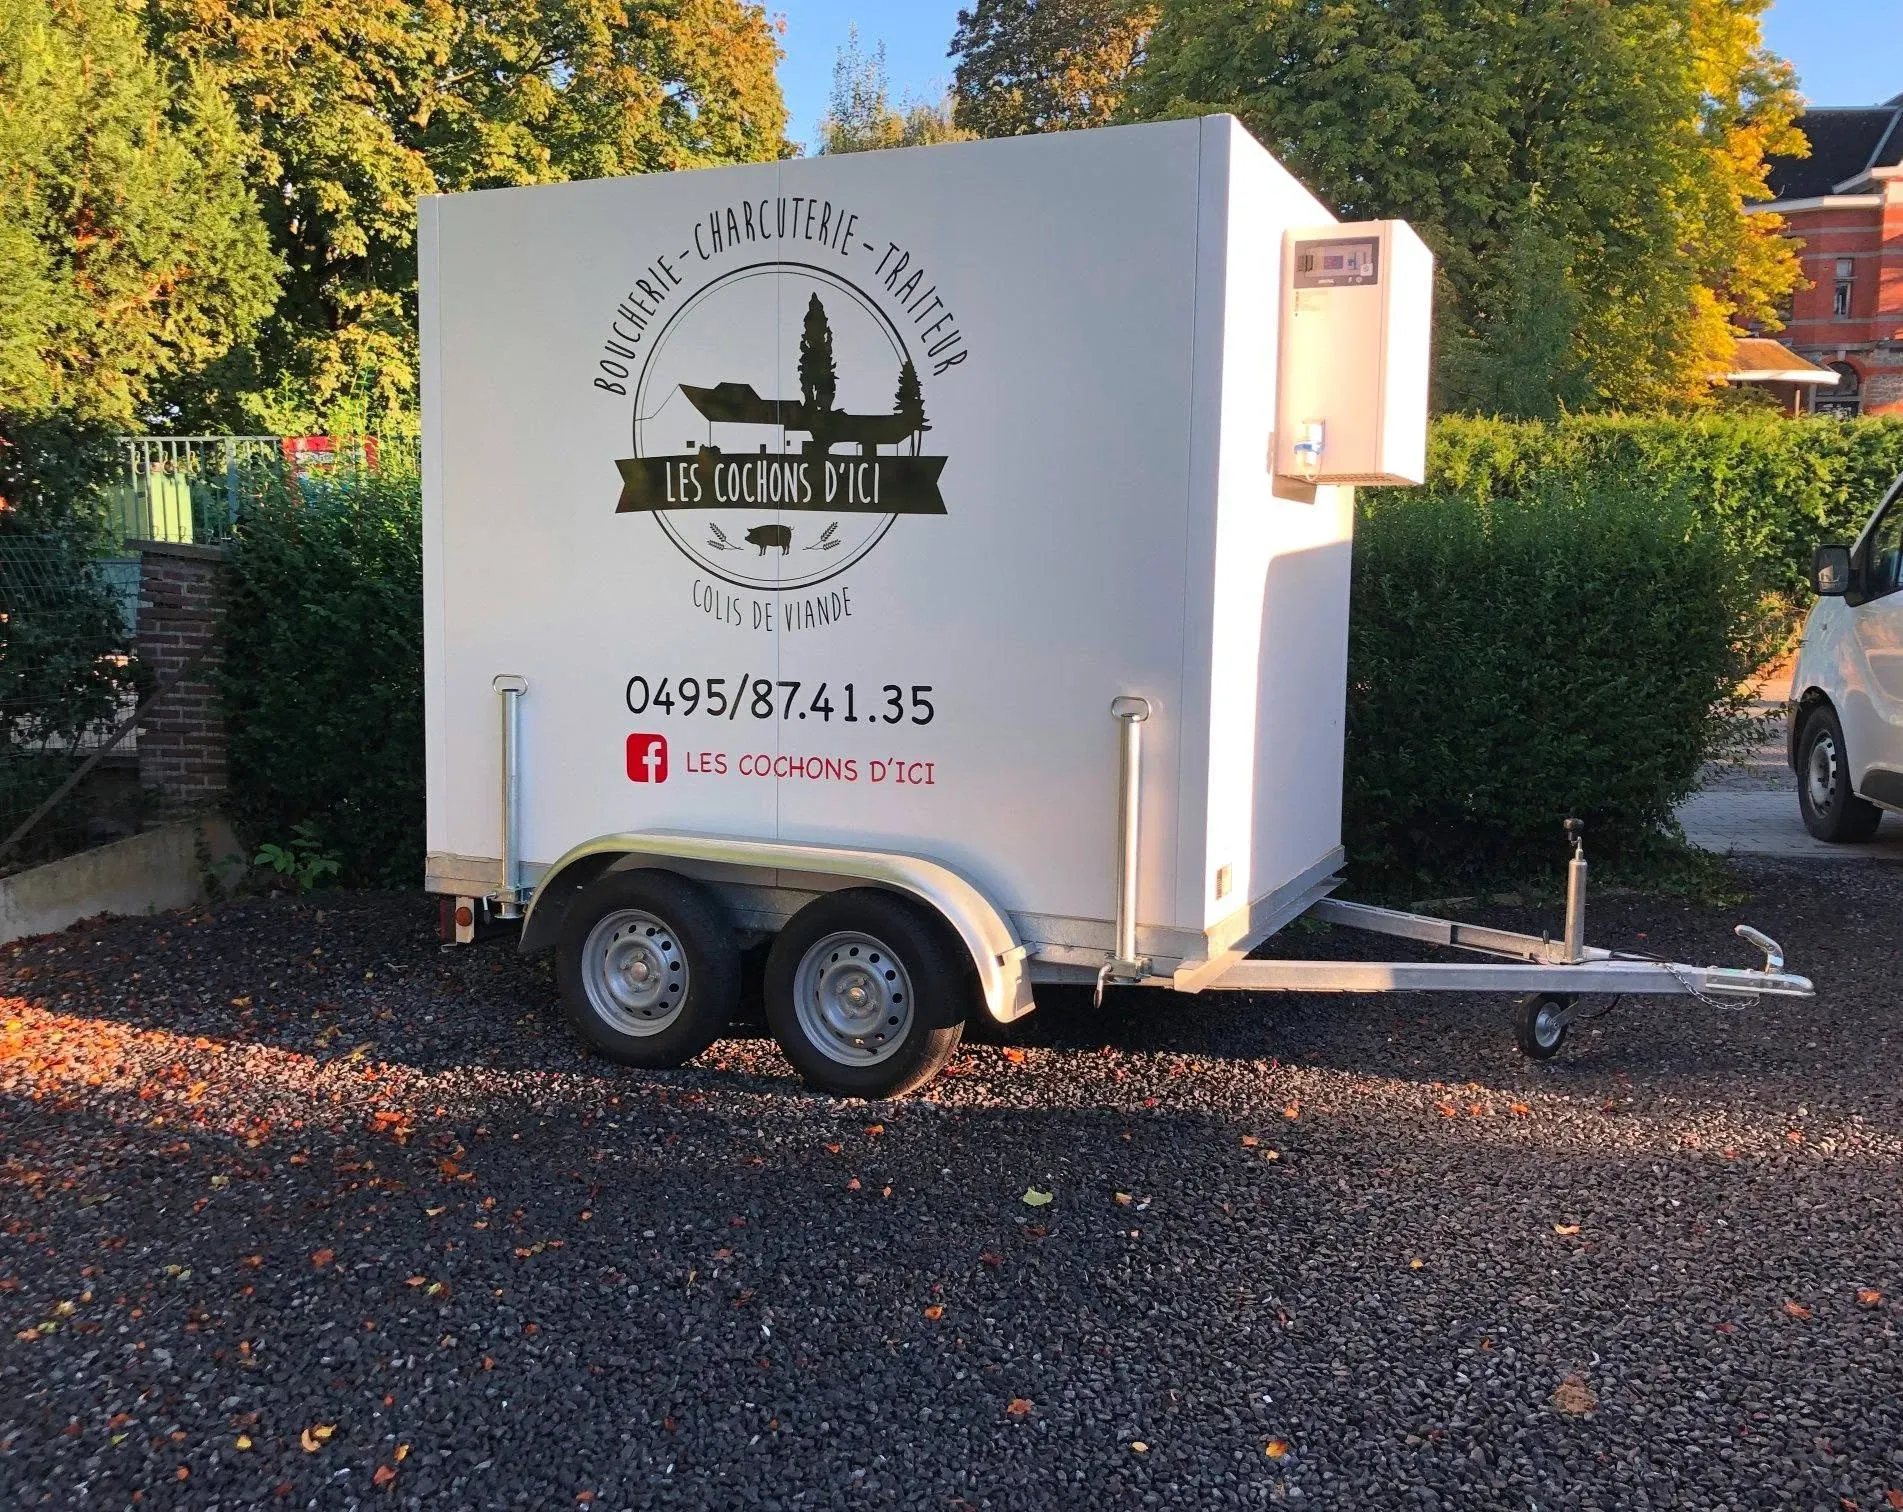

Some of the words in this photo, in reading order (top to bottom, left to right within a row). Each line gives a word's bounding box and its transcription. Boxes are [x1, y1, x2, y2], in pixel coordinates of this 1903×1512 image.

[593, 254, 683, 396] BOUCHERIE
[693, 196, 859, 262] CHARCUTERIE
[875, 241, 969, 377] TRAITEUR
[666, 461, 702, 503] LES
[714, 462, 812, 504] COCHONS
[825, 460, 881, 505] D'ICI
[692, 579, 743, 628] COLIS
[752, 601, 774, 633] DE
[784, 586, 853, 633] VIANDE
[625, 672, 936, 727] 0495/87.41.35
[686, 751, 728, 776] LES
[739, 753, 859, 781] COCHONS
[870, 756, 936, 786] D'ICI
